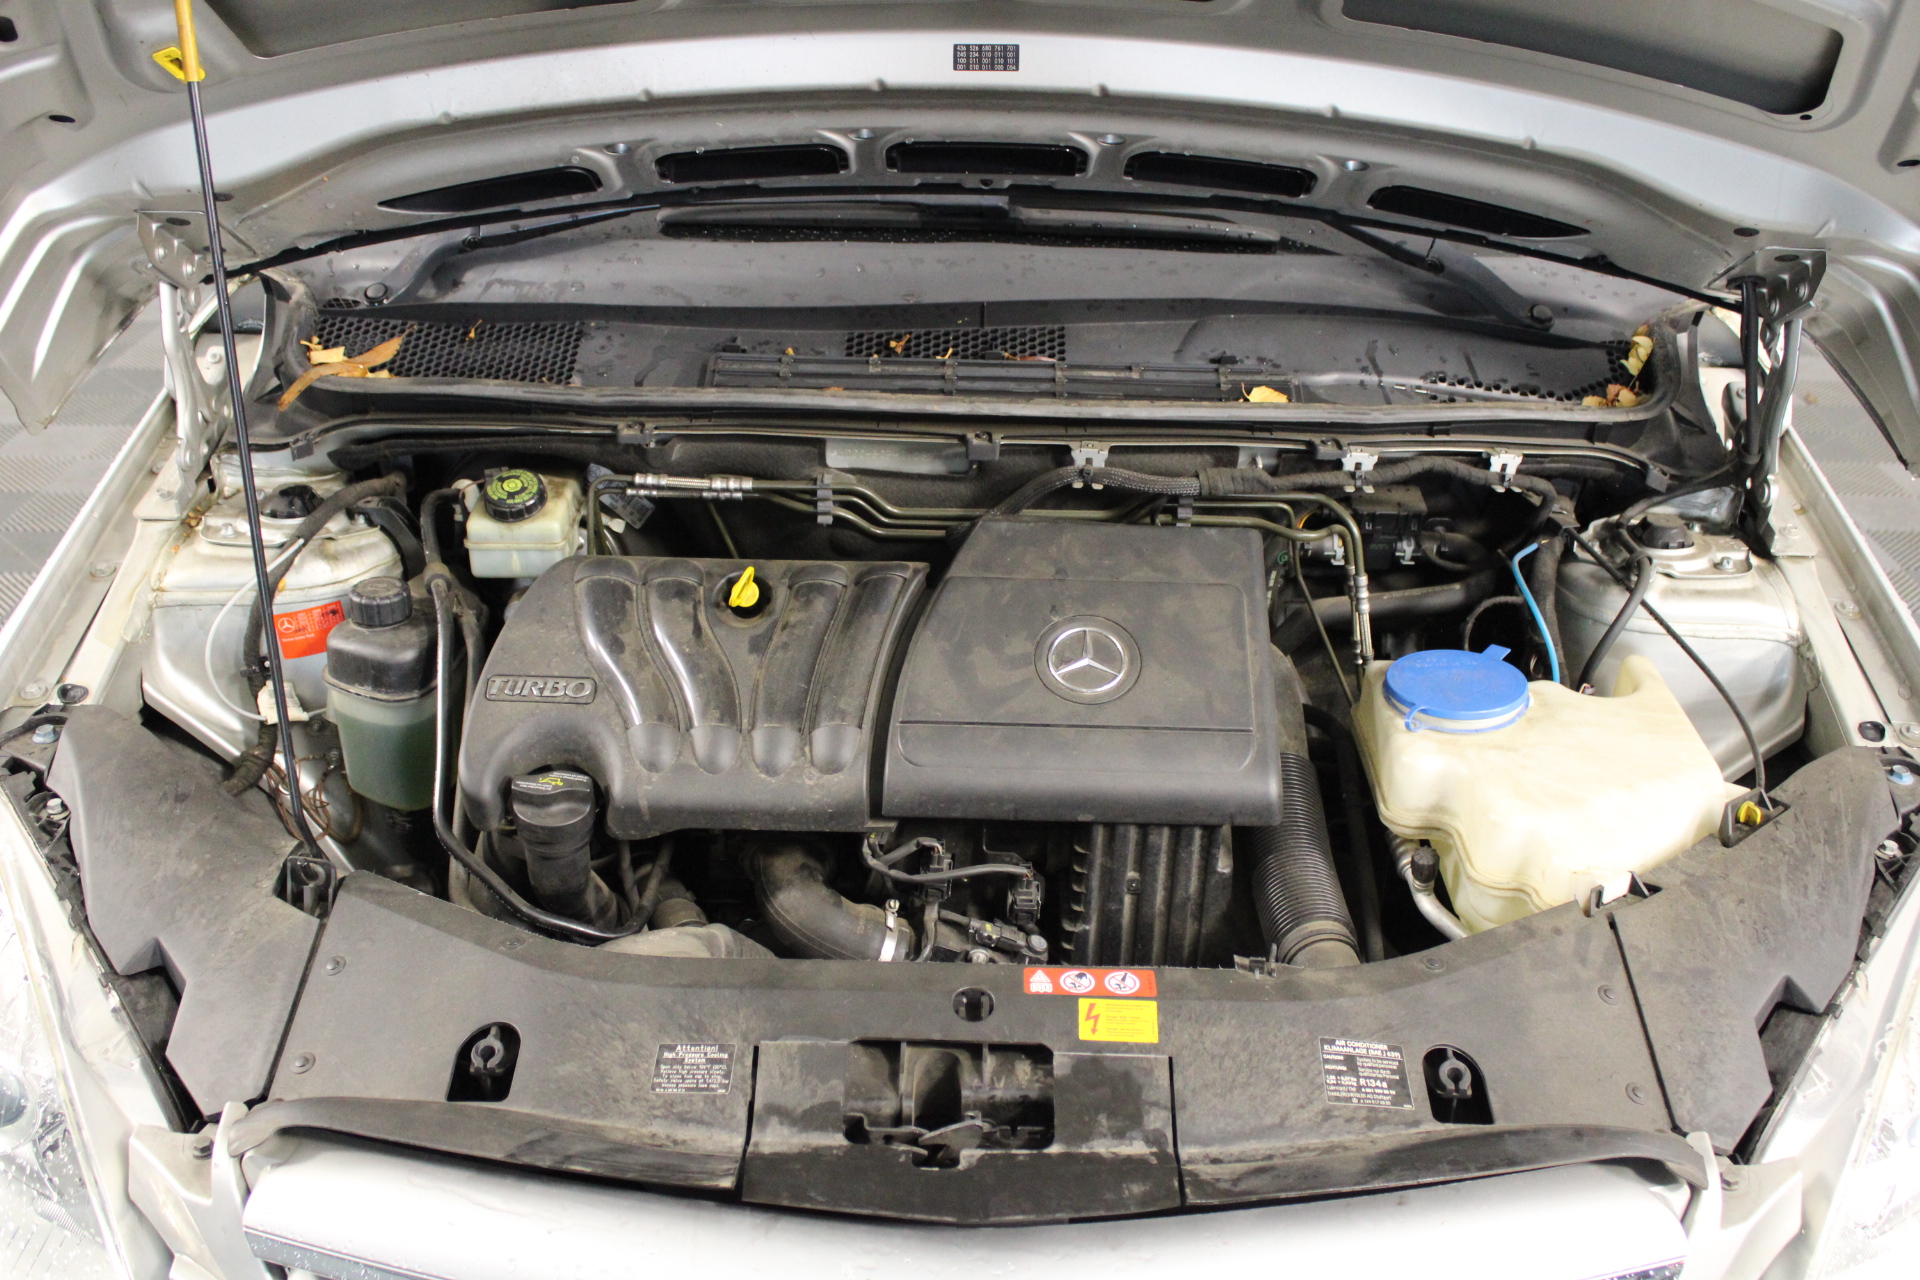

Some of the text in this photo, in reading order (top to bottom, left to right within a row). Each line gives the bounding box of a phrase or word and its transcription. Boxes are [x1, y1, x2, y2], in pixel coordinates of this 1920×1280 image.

[490, 679, 592, 698] TURBO
[1324, 1044, 1367, 1054] KLIMAANLAGE
[1347, 1041, 1388, 1050] CONDITIONER
[1360, 1078, 1388, 1088] R134a
